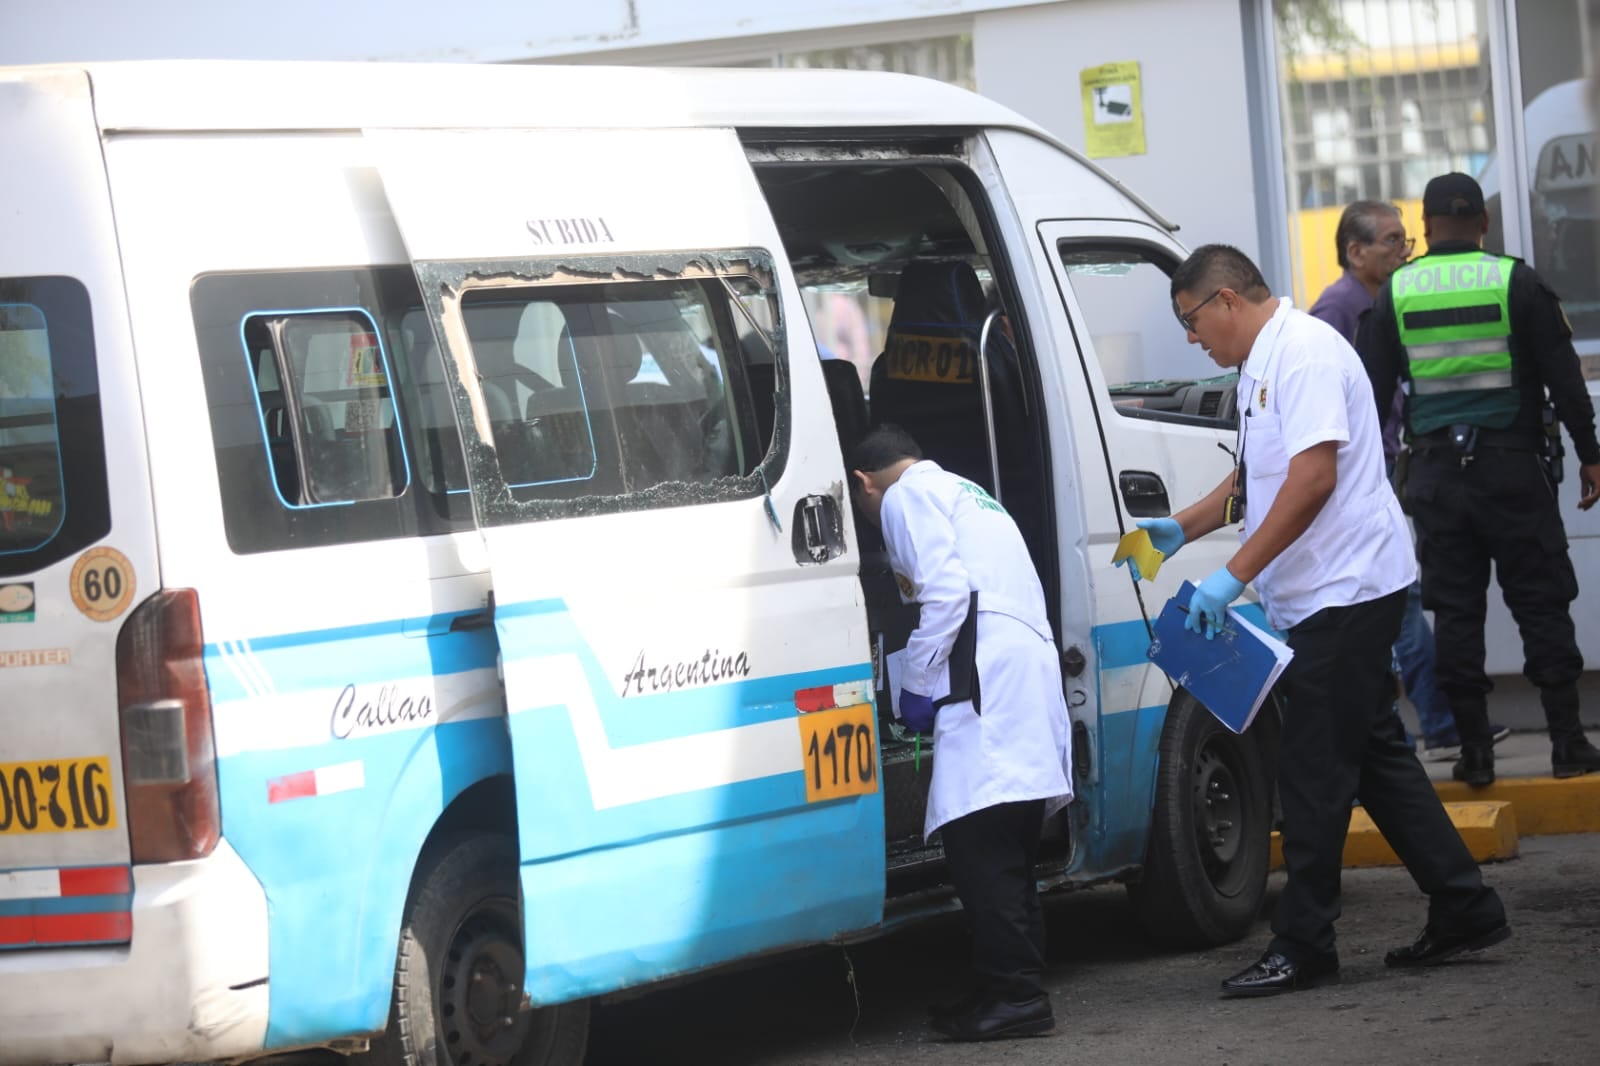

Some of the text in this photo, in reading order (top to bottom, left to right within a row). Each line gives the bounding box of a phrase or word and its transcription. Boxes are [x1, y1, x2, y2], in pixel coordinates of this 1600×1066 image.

[526, 217, 615, 245] SUBIDA
[1398, 263, 1504, 296] POLICIA
[84, 566, 121, 602] 60
[621, 648, 751, 698] Argentina
[330, 683, 432, 740] Callao
[808, 723, 872, 790] 1170
